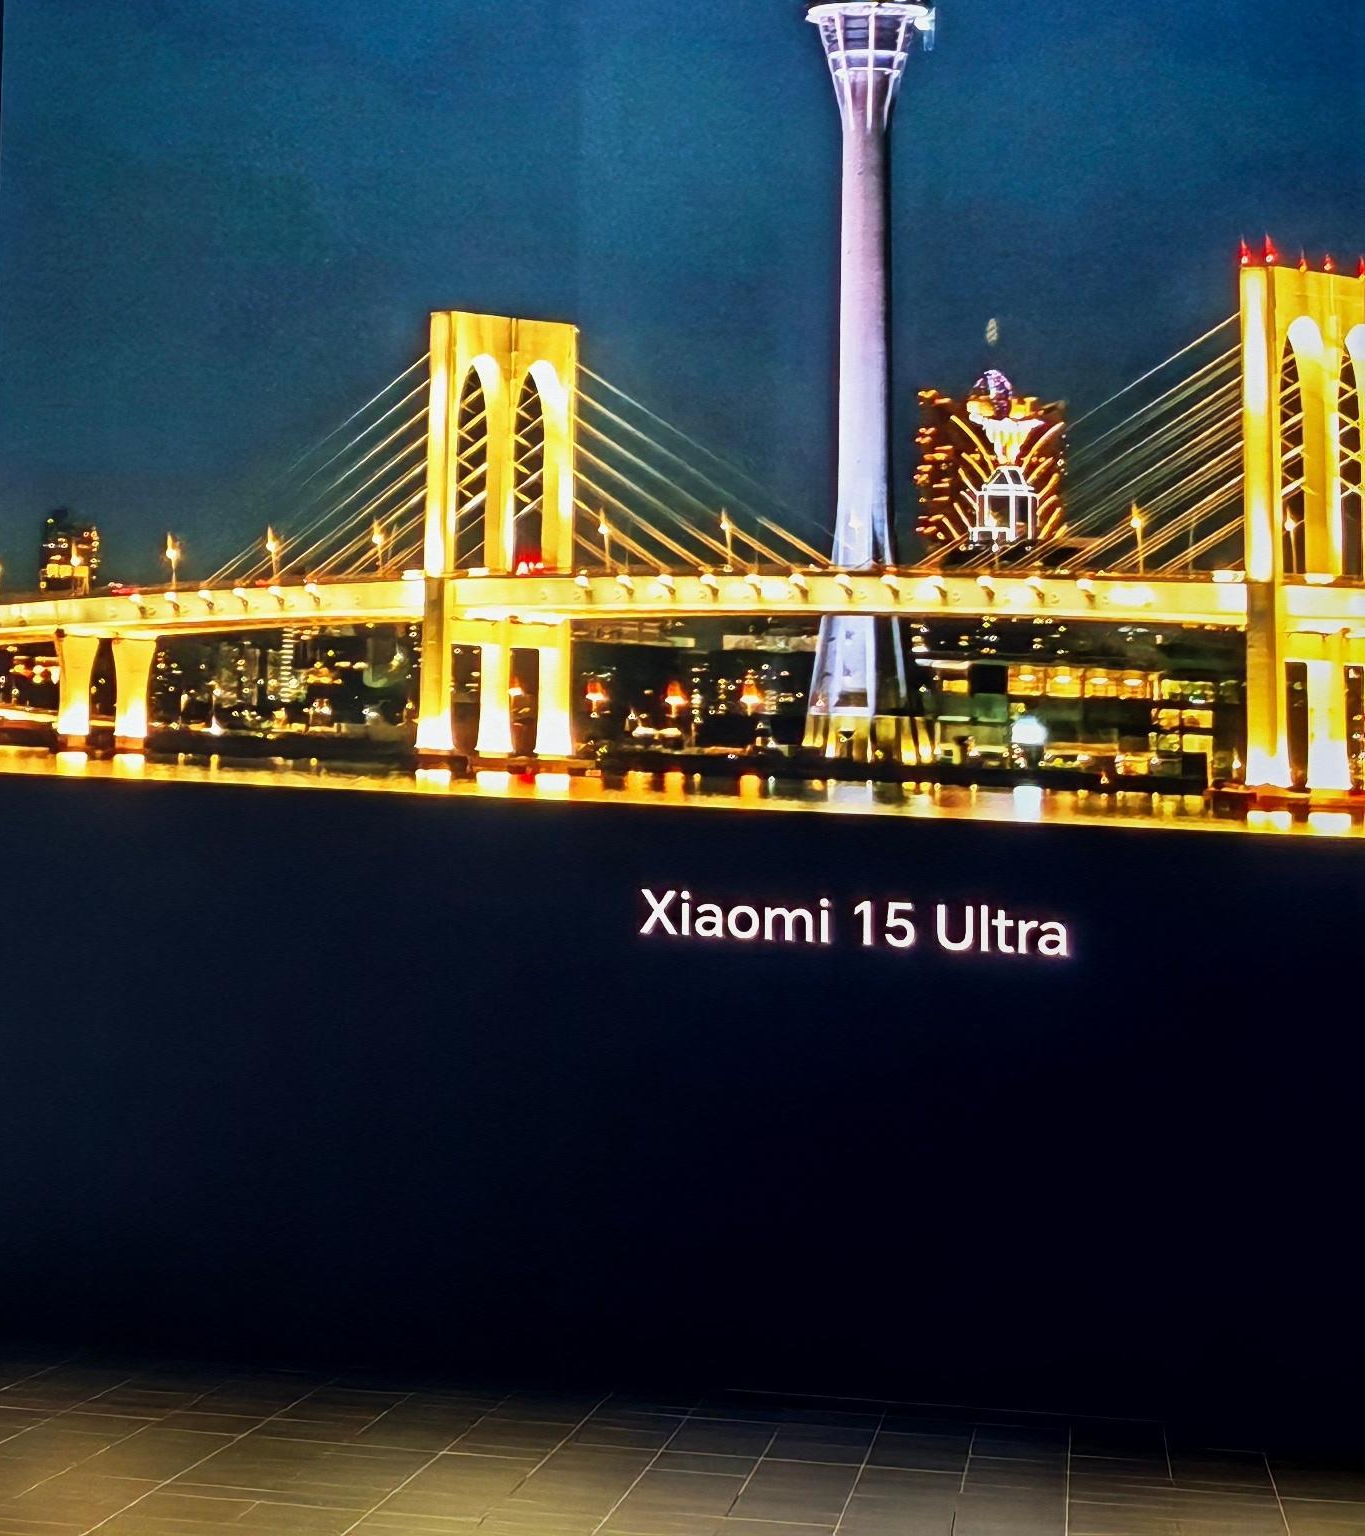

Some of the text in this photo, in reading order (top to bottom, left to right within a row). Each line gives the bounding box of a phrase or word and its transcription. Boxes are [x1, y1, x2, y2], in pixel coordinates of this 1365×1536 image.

[639, 888, 1070, 958] Xiaomi 15 Ultra
